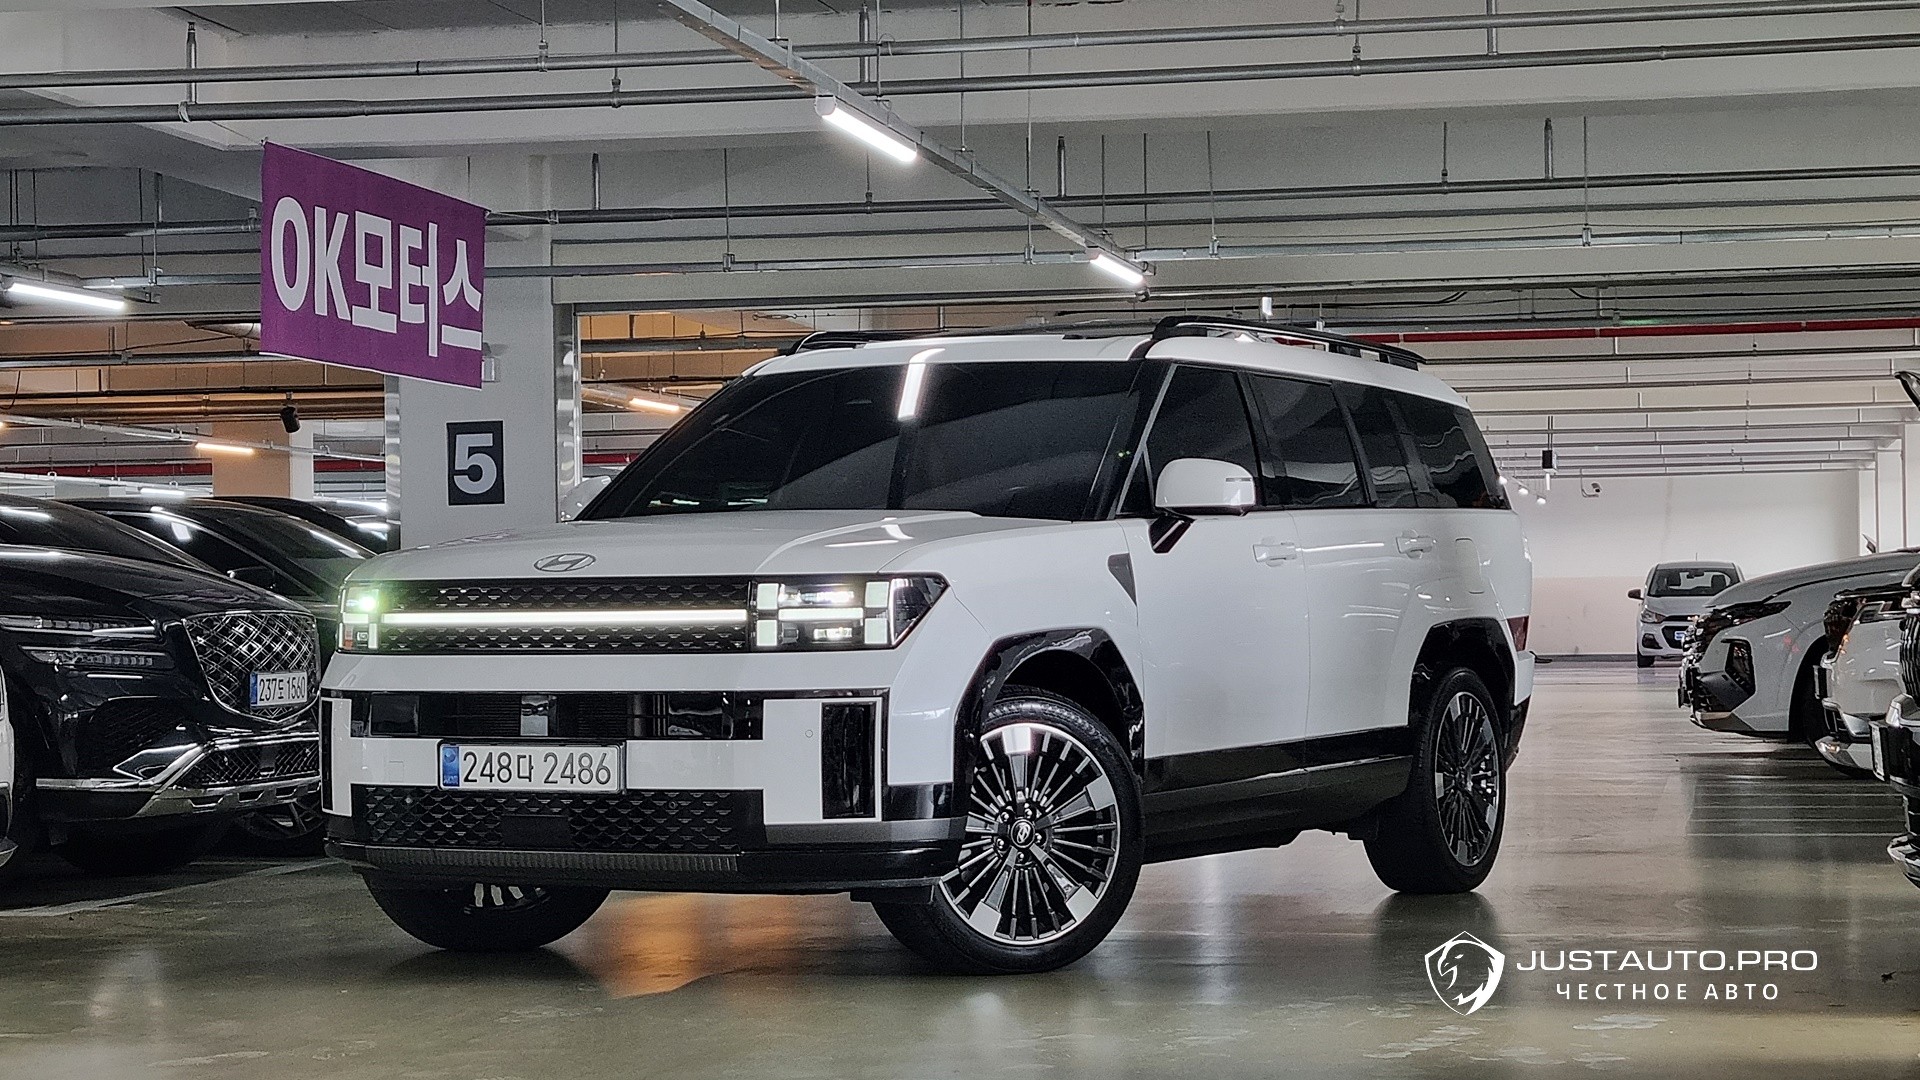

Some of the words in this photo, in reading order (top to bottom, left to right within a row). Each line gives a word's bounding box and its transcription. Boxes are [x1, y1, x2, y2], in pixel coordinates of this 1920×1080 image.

[271, 196, 482, 357] OK모터스
[453, 433, 497, 494] 5
[259, 678, 284, 701] 237도
[287, 676, 306, 699] 1560
[463, 751, 534, 783] 248다
[543, 752, 611, 785] 2486
